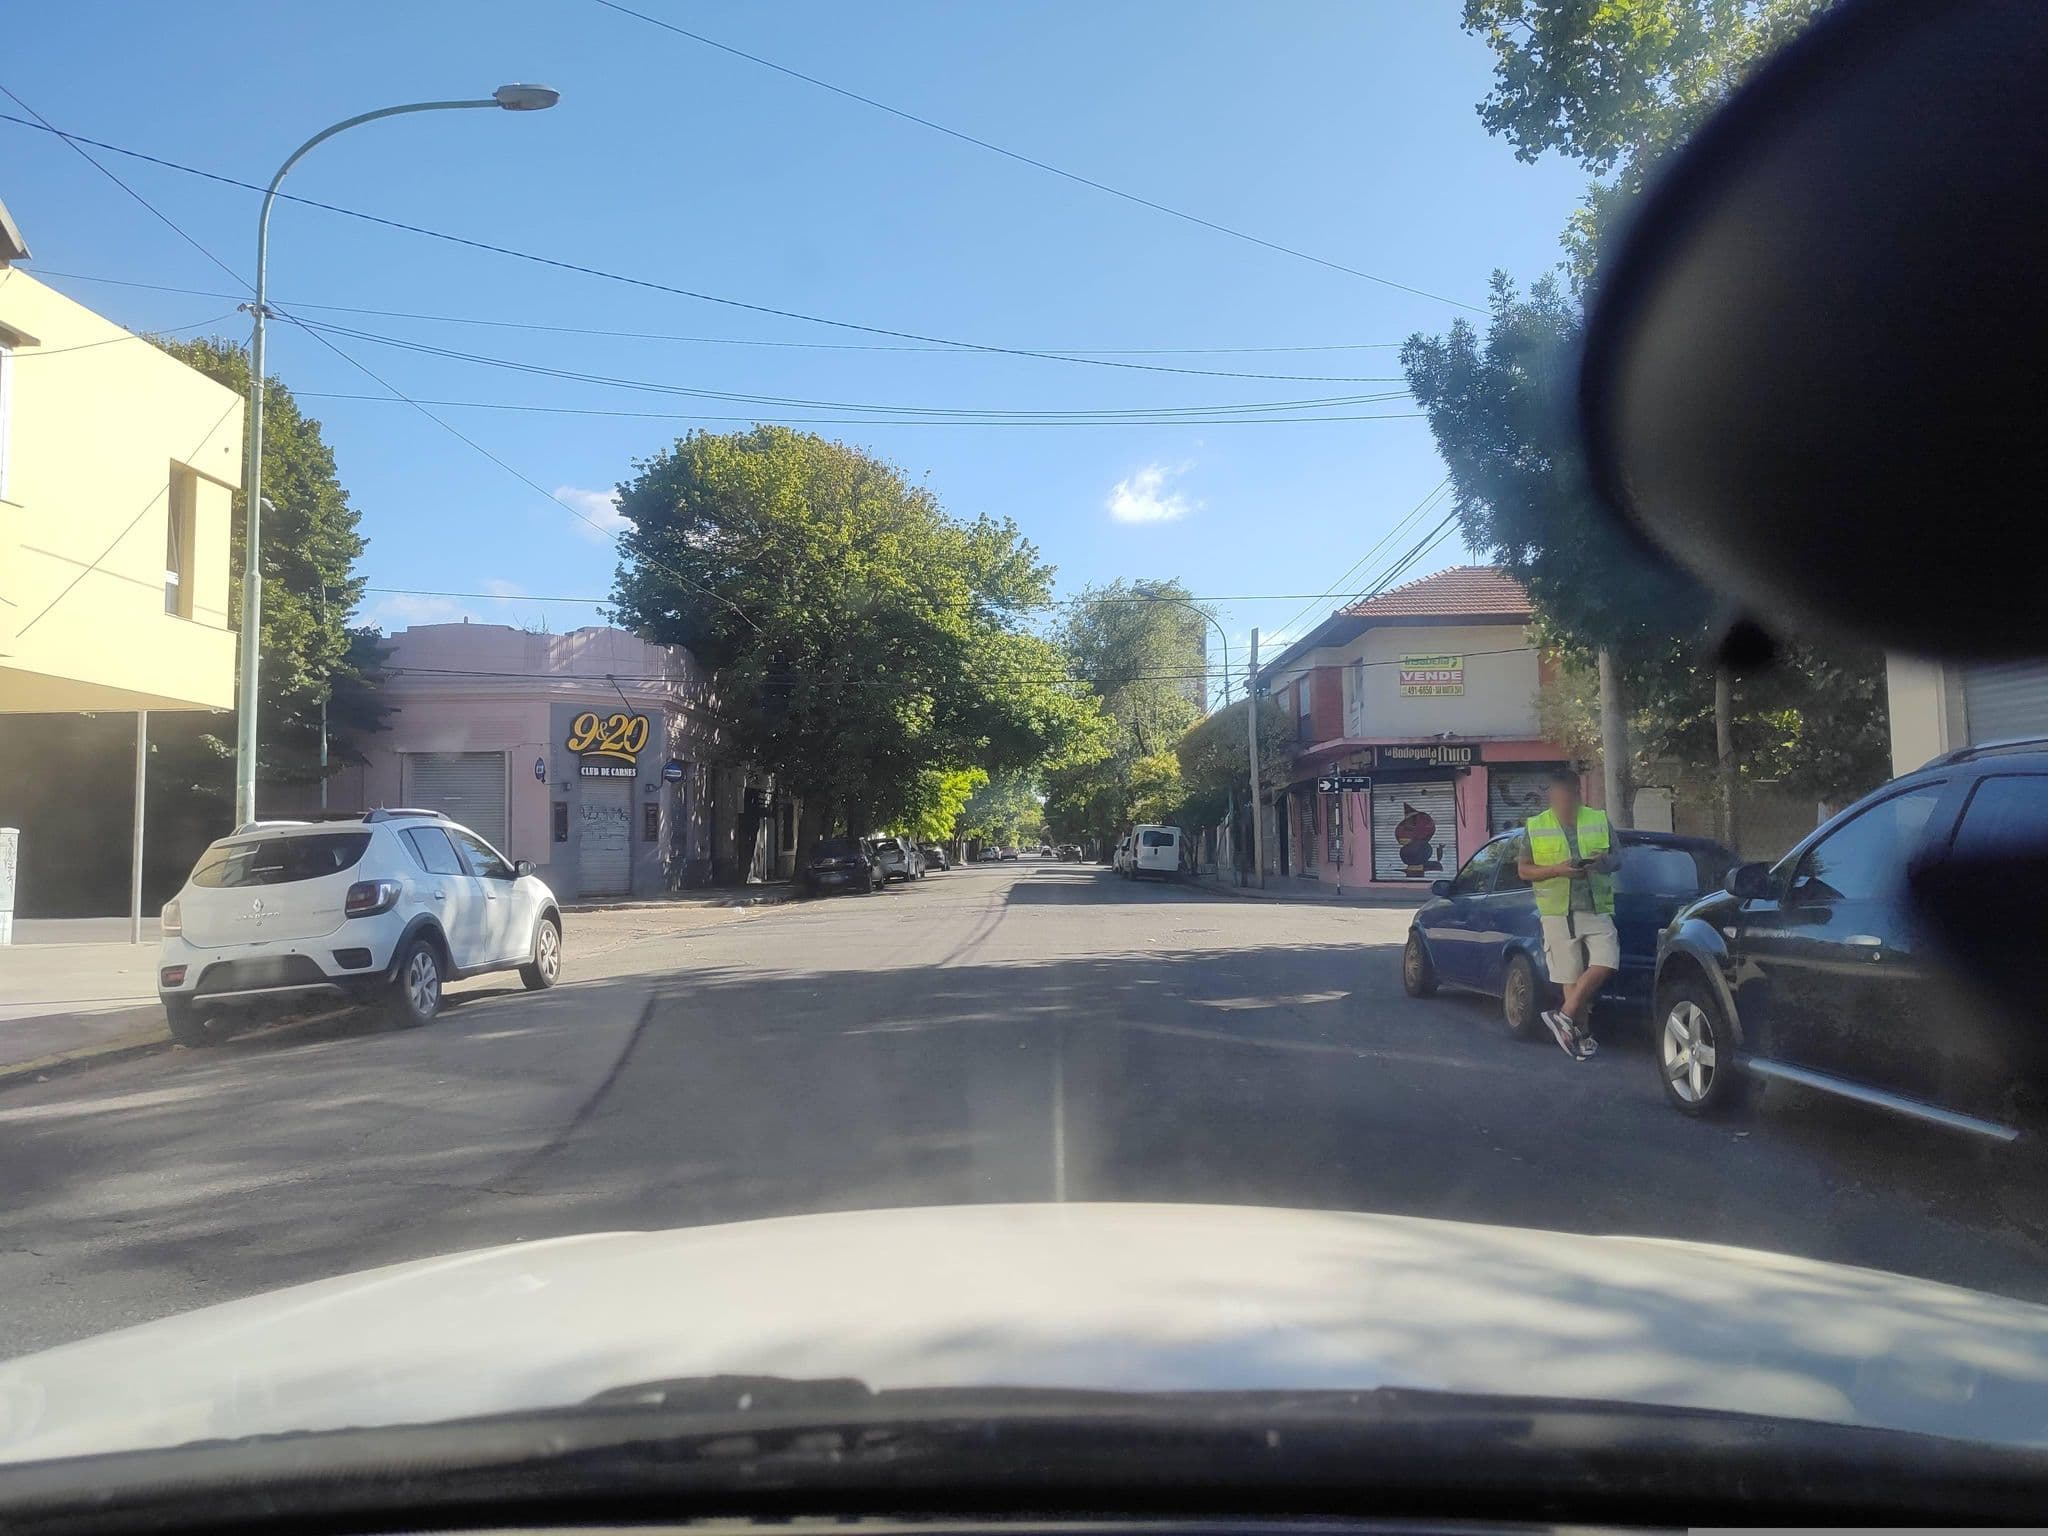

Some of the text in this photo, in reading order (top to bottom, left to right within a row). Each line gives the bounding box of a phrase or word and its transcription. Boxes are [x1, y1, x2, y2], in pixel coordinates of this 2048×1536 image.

[1401, 671, 1462, 681] VENDE
[568, 712, 649, 753] 9&20
[1392, 747, 1437, 760] Bodeguita
[581, 766, 637, 777] CLUB DE CARNES
